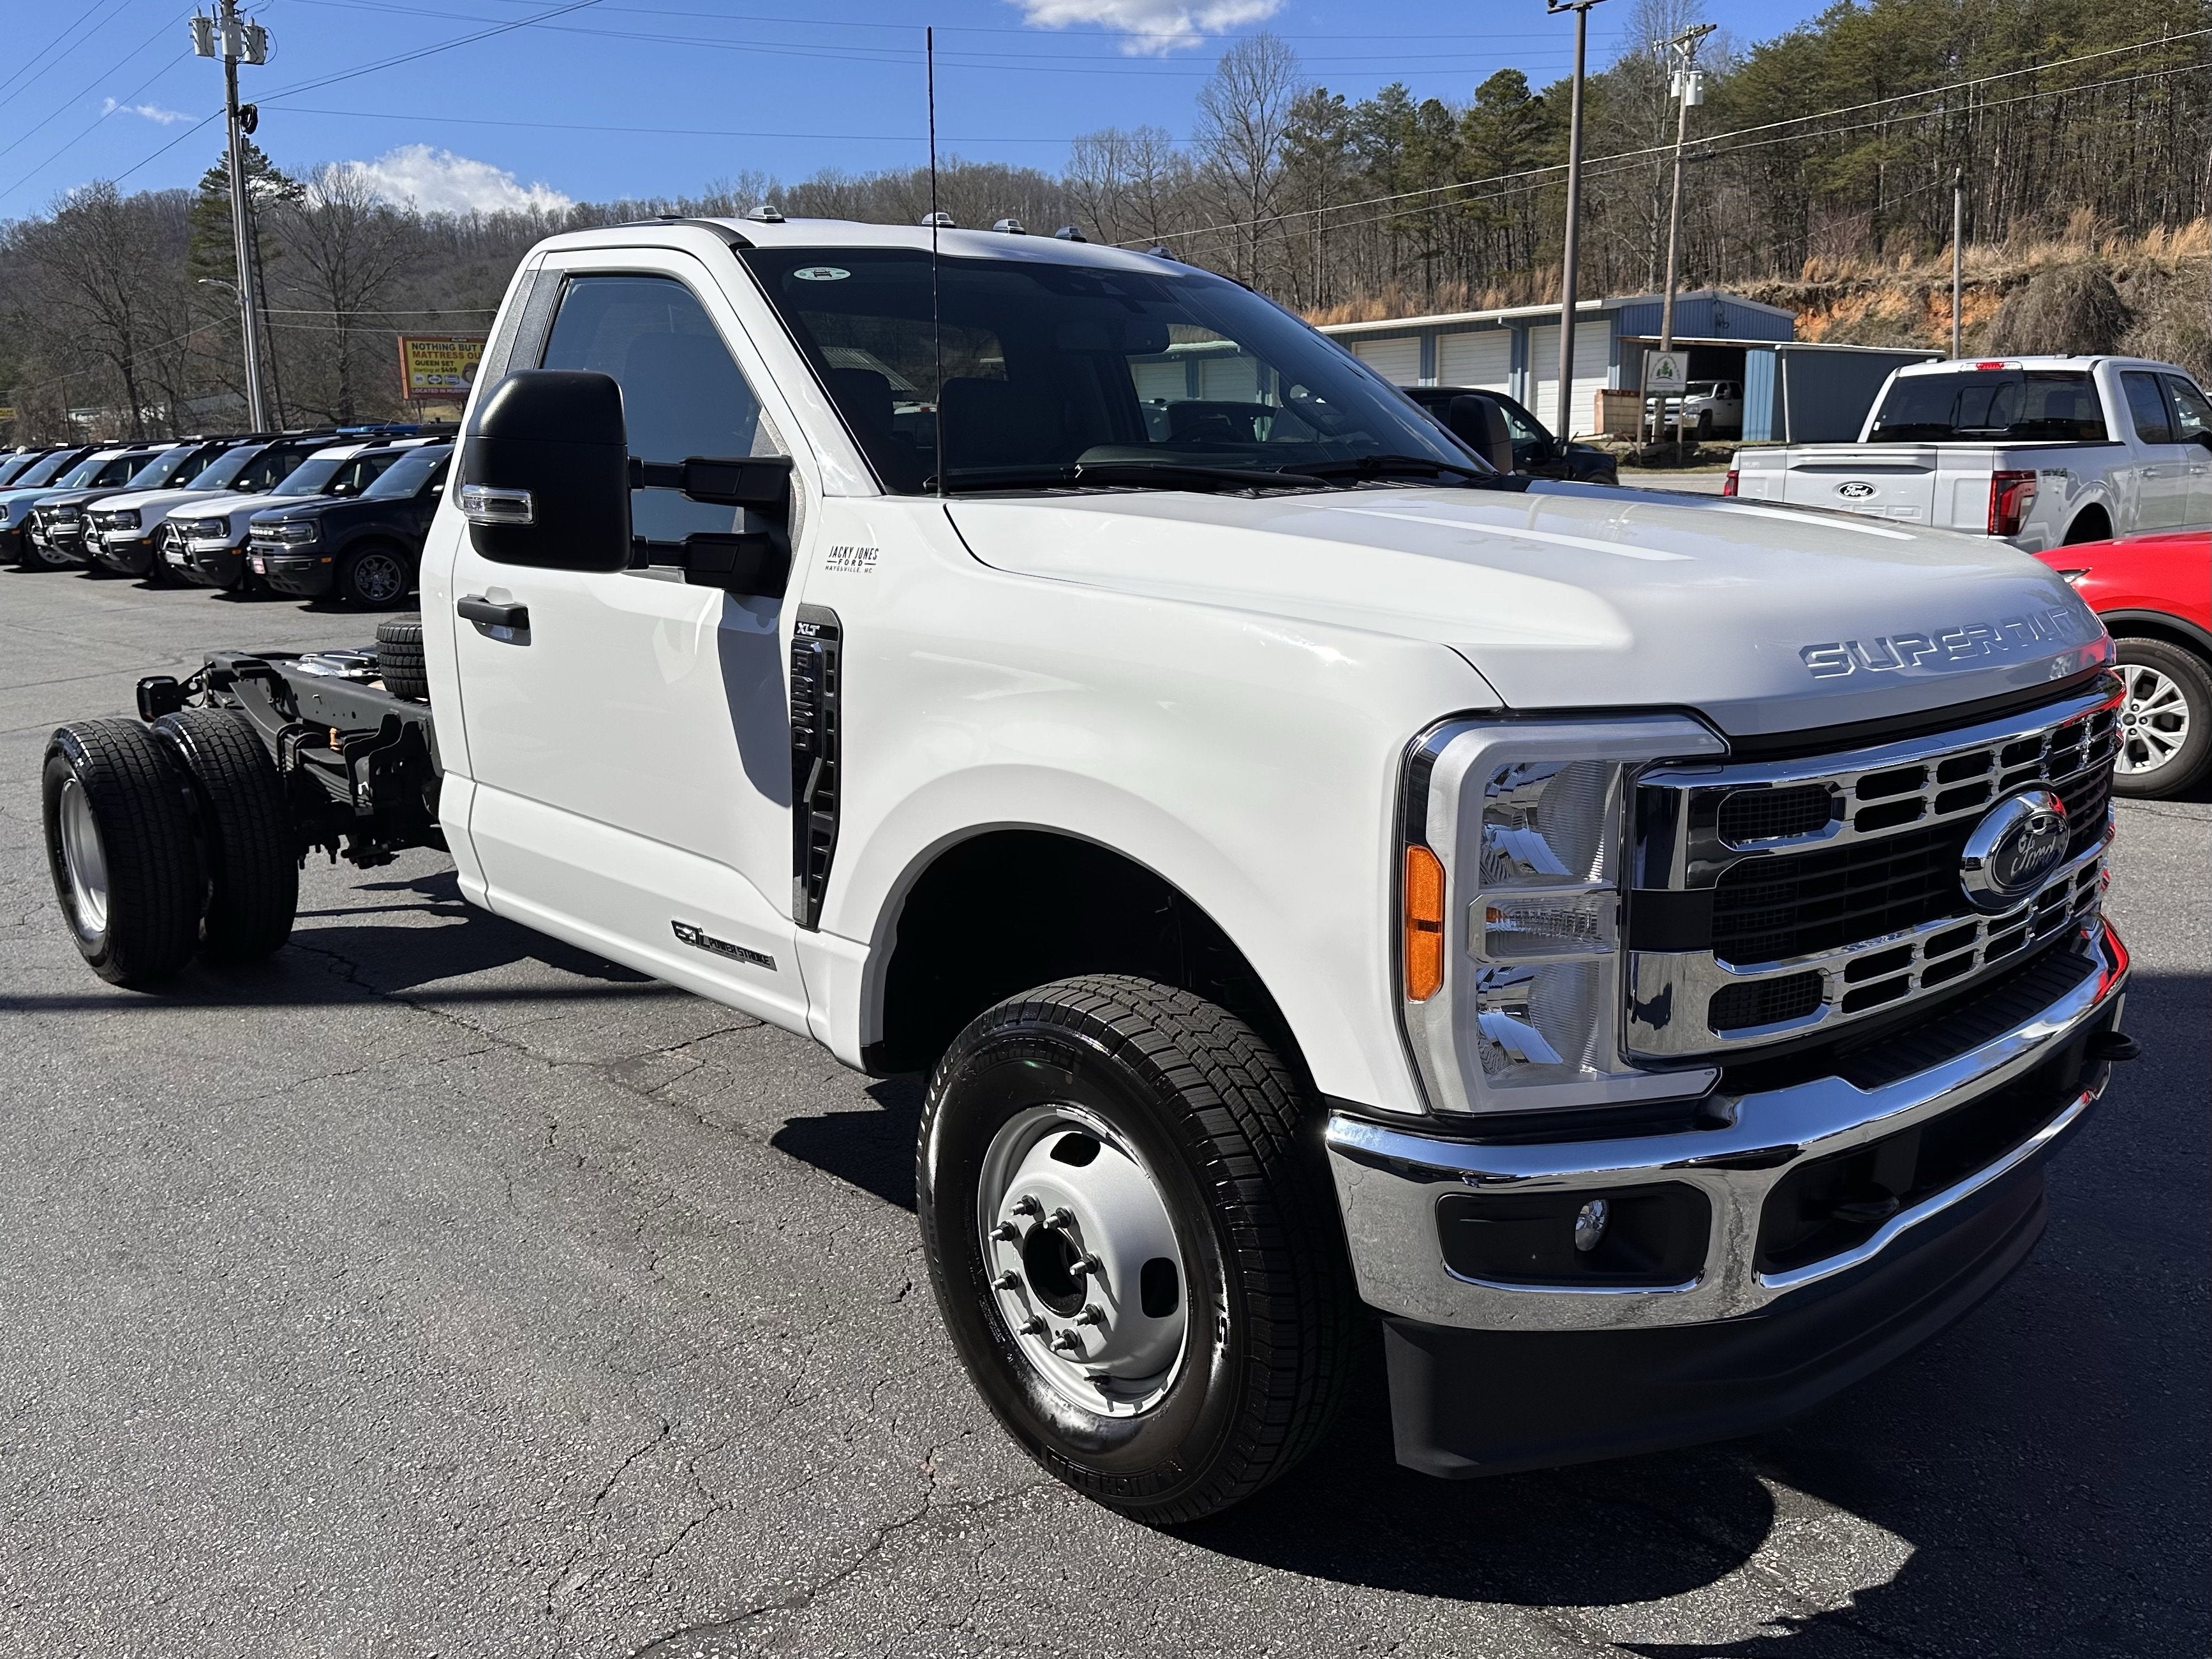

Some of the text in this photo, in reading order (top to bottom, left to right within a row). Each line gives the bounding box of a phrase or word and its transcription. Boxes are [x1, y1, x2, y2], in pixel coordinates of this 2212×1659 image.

[412, 342, 456, 351] NOTHING
[412, 351, 464, 359] MATTRESS
[1843, 485, 1869, 496] Ford
[828, 545, 879, 560] JACKY JONES
[838, 558, 863, 567] FORD
[796, 622, 820, 637] XLT
[1798, 622, 2009, 680] SUPER
[2010, 831, 2057, 879] Ford
